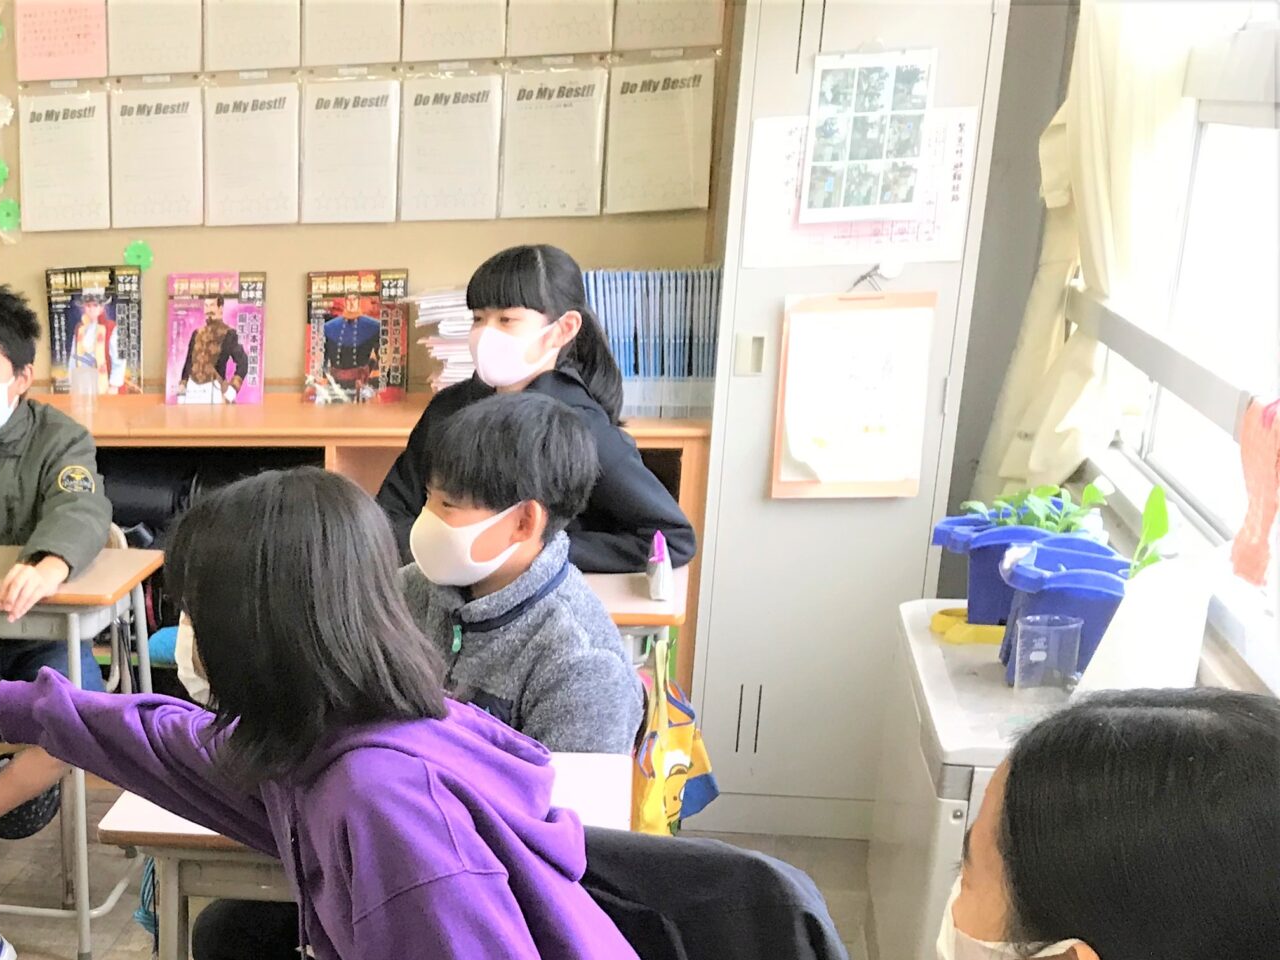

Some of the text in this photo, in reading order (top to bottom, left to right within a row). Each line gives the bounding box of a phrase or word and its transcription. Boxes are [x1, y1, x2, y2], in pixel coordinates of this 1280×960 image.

[517, 84, 595, 101] Do My Best!!
[620, 74, 702, 95] Do My Best!!
[215, 96, 287, 115] Do My Best!!
[315, 94, 390, 110] Do My Best!!
[414, 89, 490, 106] Do My Best!!
[29, 105, 96, 124] Do My Best!!
[120, 101, 190, 117] Do My Best!!
[241, 281, 263, 290] マンガ
